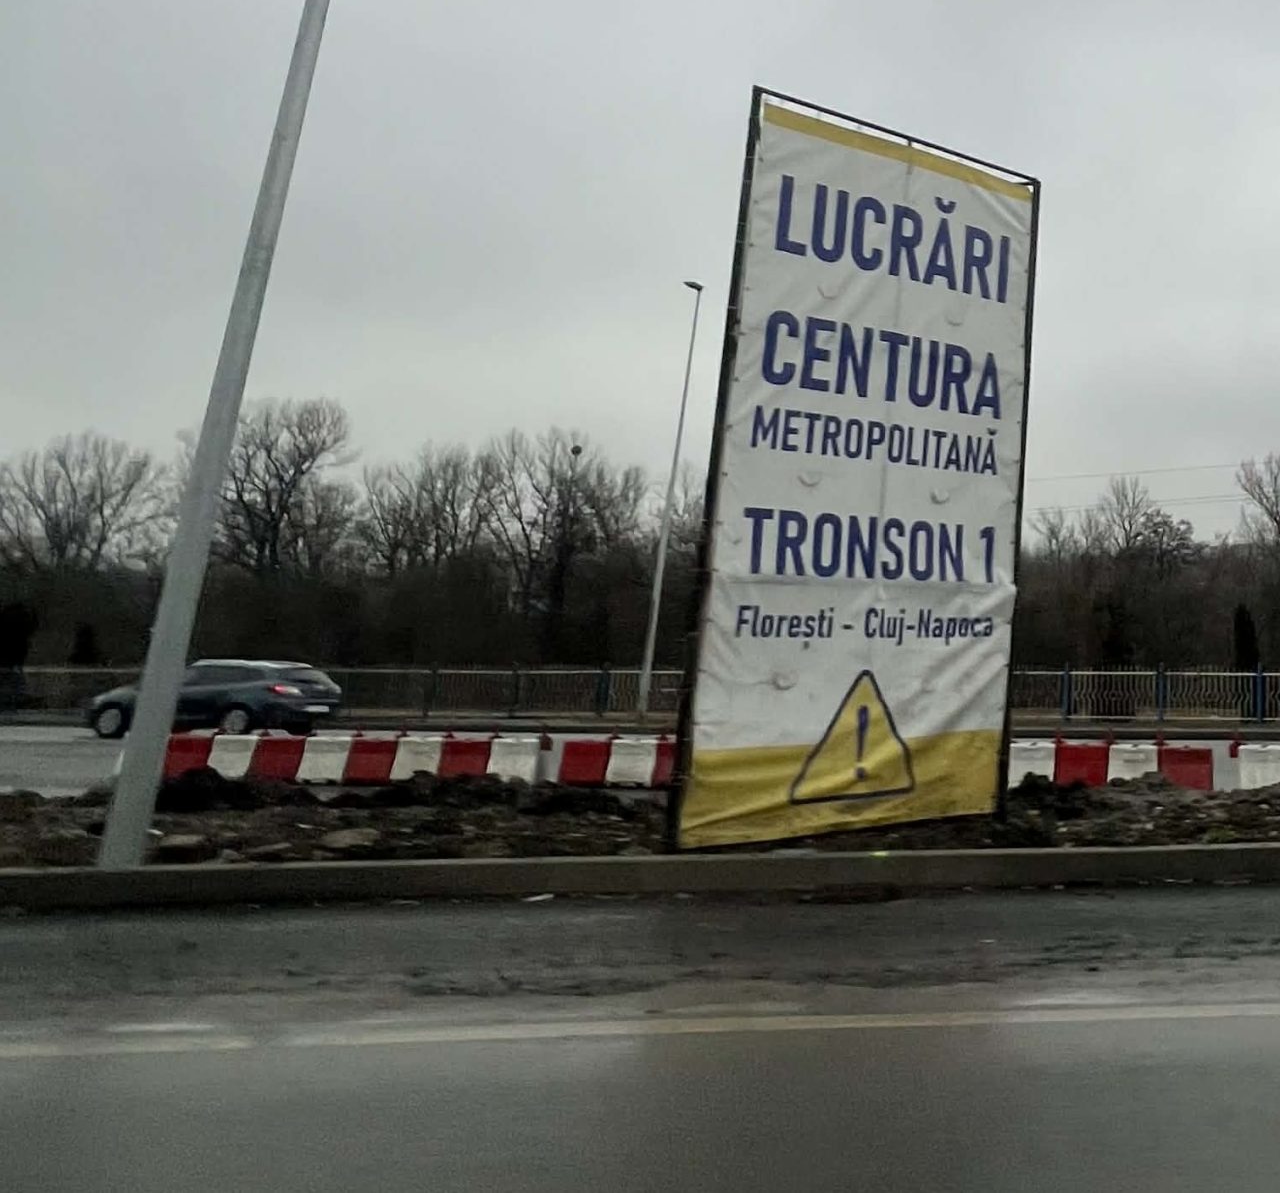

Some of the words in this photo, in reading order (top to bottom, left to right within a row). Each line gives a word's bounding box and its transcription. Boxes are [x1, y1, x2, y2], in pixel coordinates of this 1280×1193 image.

[774, 174, 1011, 303] LUCRĂRI
[761, 310, 1002, 420] CENTURA
[750, 405, 998, 475] METROPOLITANĂ
[744, 507, 965, 582] TRONSON
[979, 525, 996, 583] 1
[863, 607, 994, 646] Cluj-Napoca
